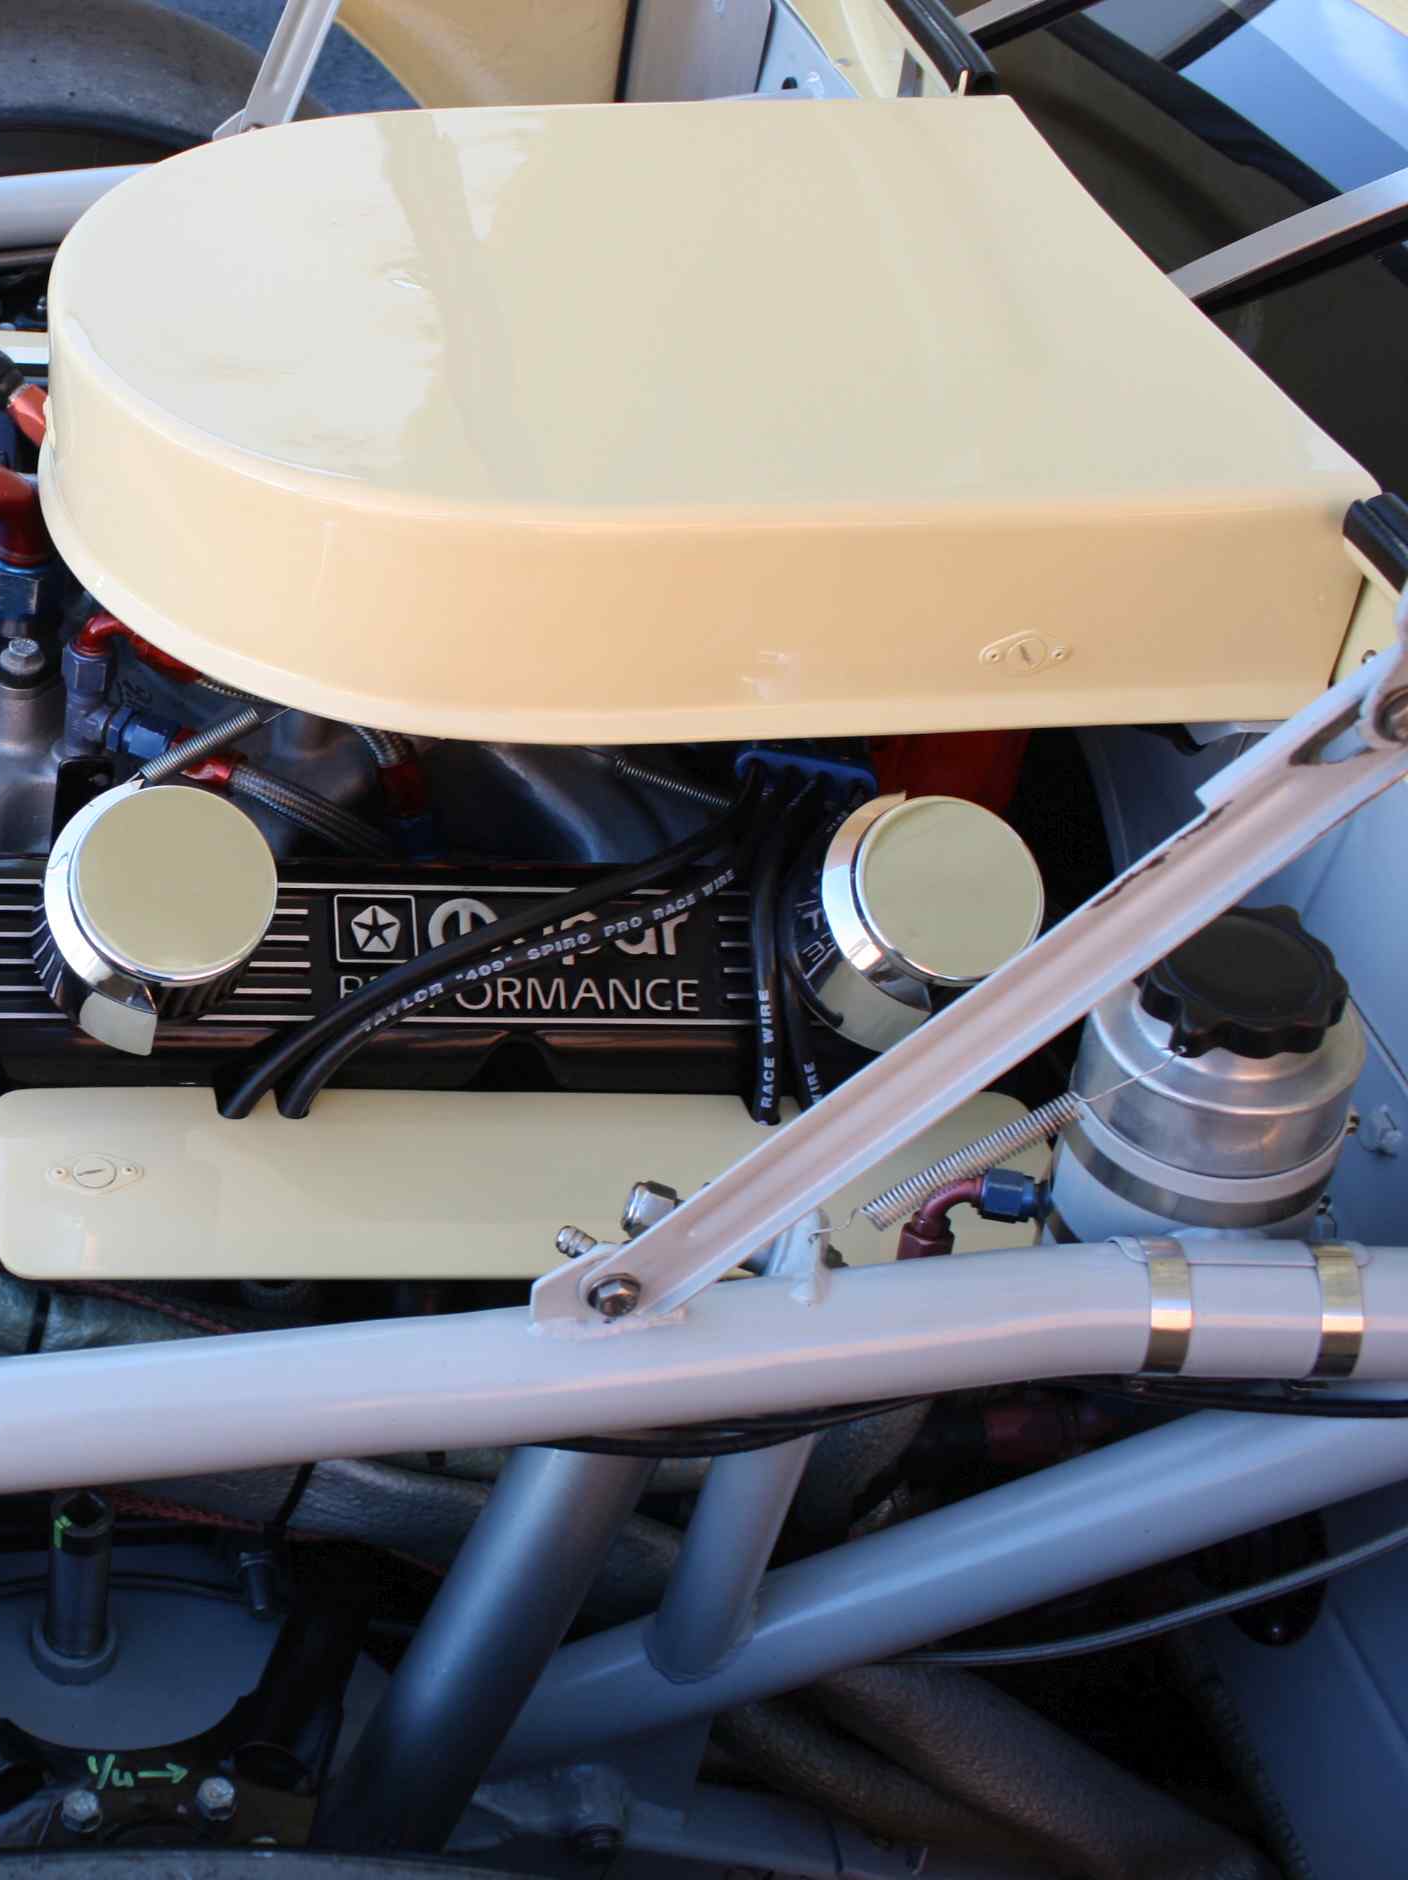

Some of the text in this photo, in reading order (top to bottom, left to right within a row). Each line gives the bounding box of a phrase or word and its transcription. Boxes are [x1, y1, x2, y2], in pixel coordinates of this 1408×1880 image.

[527, 932, 591, 960] SPIRO
[603, 916, 642, 938] PRO
[652, 893, 696, 920] RACE
[701, 869, 736, 896] WIRE
[340, 975, 700, 1012] PORMANCE
[758, 989, 775, 1044] WIRE
[760, 1056, 775, 1109] RACE
